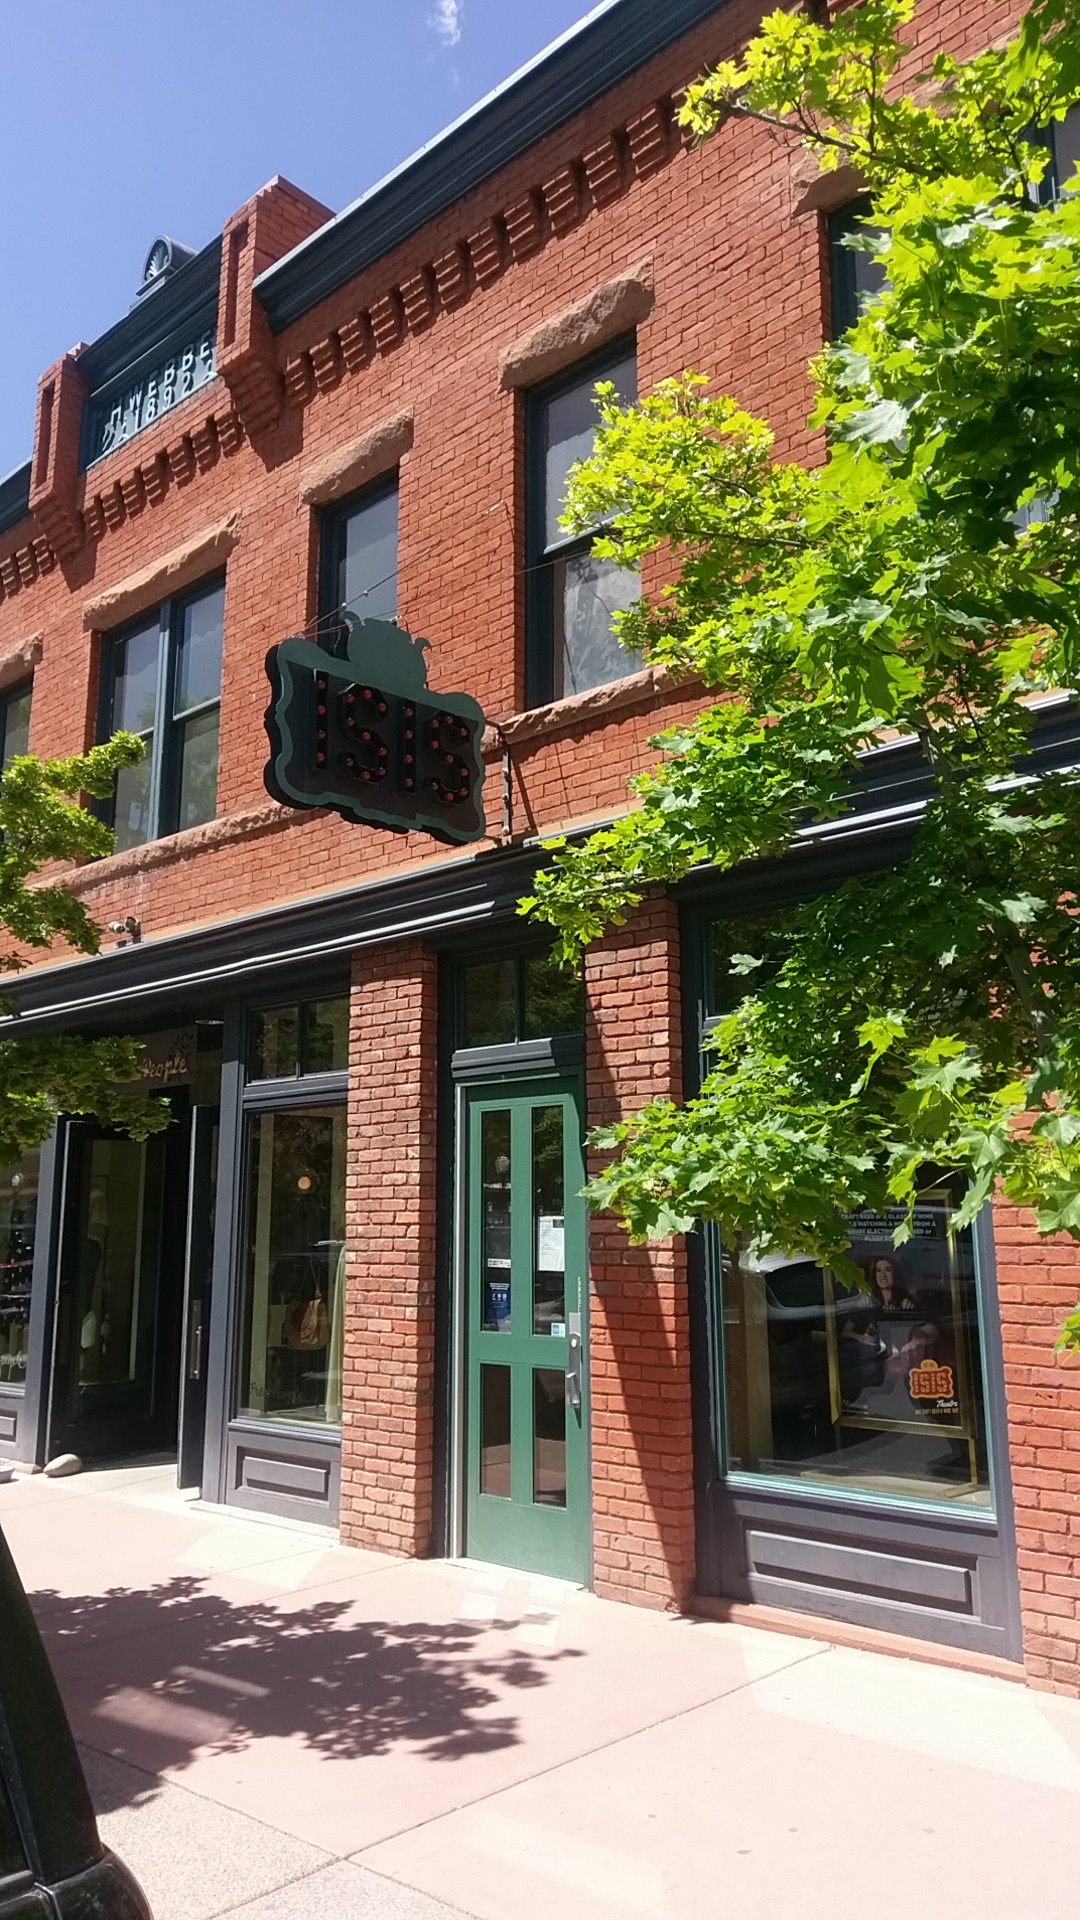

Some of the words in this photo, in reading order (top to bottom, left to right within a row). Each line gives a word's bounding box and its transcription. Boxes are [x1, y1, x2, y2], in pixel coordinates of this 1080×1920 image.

[133, 371, 193, 433] 1892
[310, 667, 470, 806] ISIS
[914, 1372, 948, 1393] ISIS
